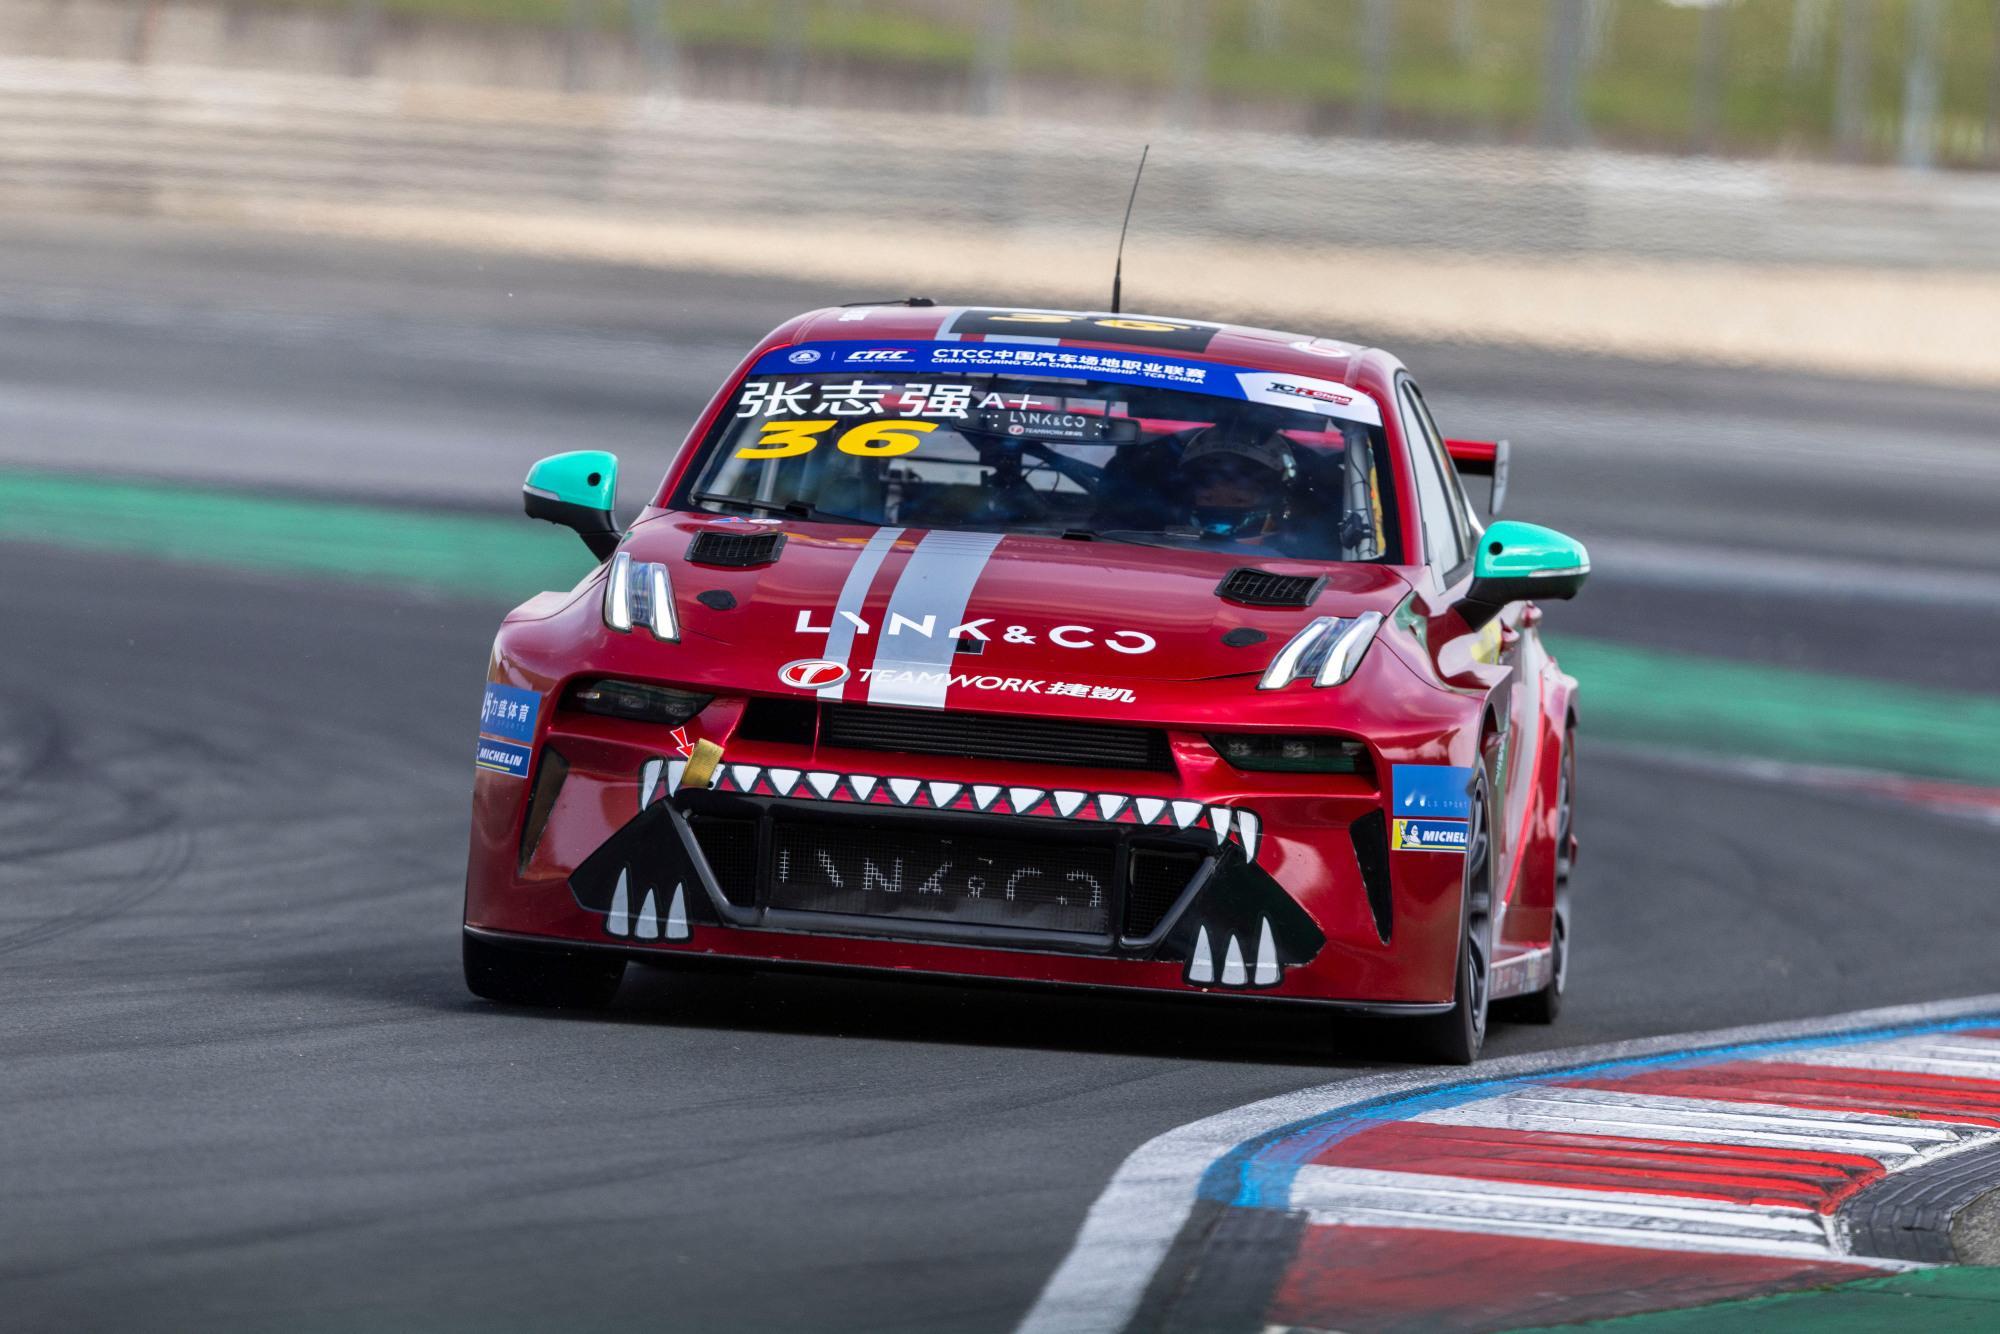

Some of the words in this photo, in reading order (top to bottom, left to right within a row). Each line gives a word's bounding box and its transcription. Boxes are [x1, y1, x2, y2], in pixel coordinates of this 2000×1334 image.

[847, 351, 909, 360] CTCC
[970, 358, 1021, 366] TOURING
[1048, 362, 1137, 376] CHAMPIONSHIP
[1143, 371, 1166, 379] TCR
[1167, 374, 1204, 385] CHINA
[736, 380, 973, 419] 张志强
[977, 393, 1042, 411] A+
[735, 420, 939, 459] 36
[858, 668, 1046, 694] TEAMWORK
[480, 747, 523, 766] MICHELIN
